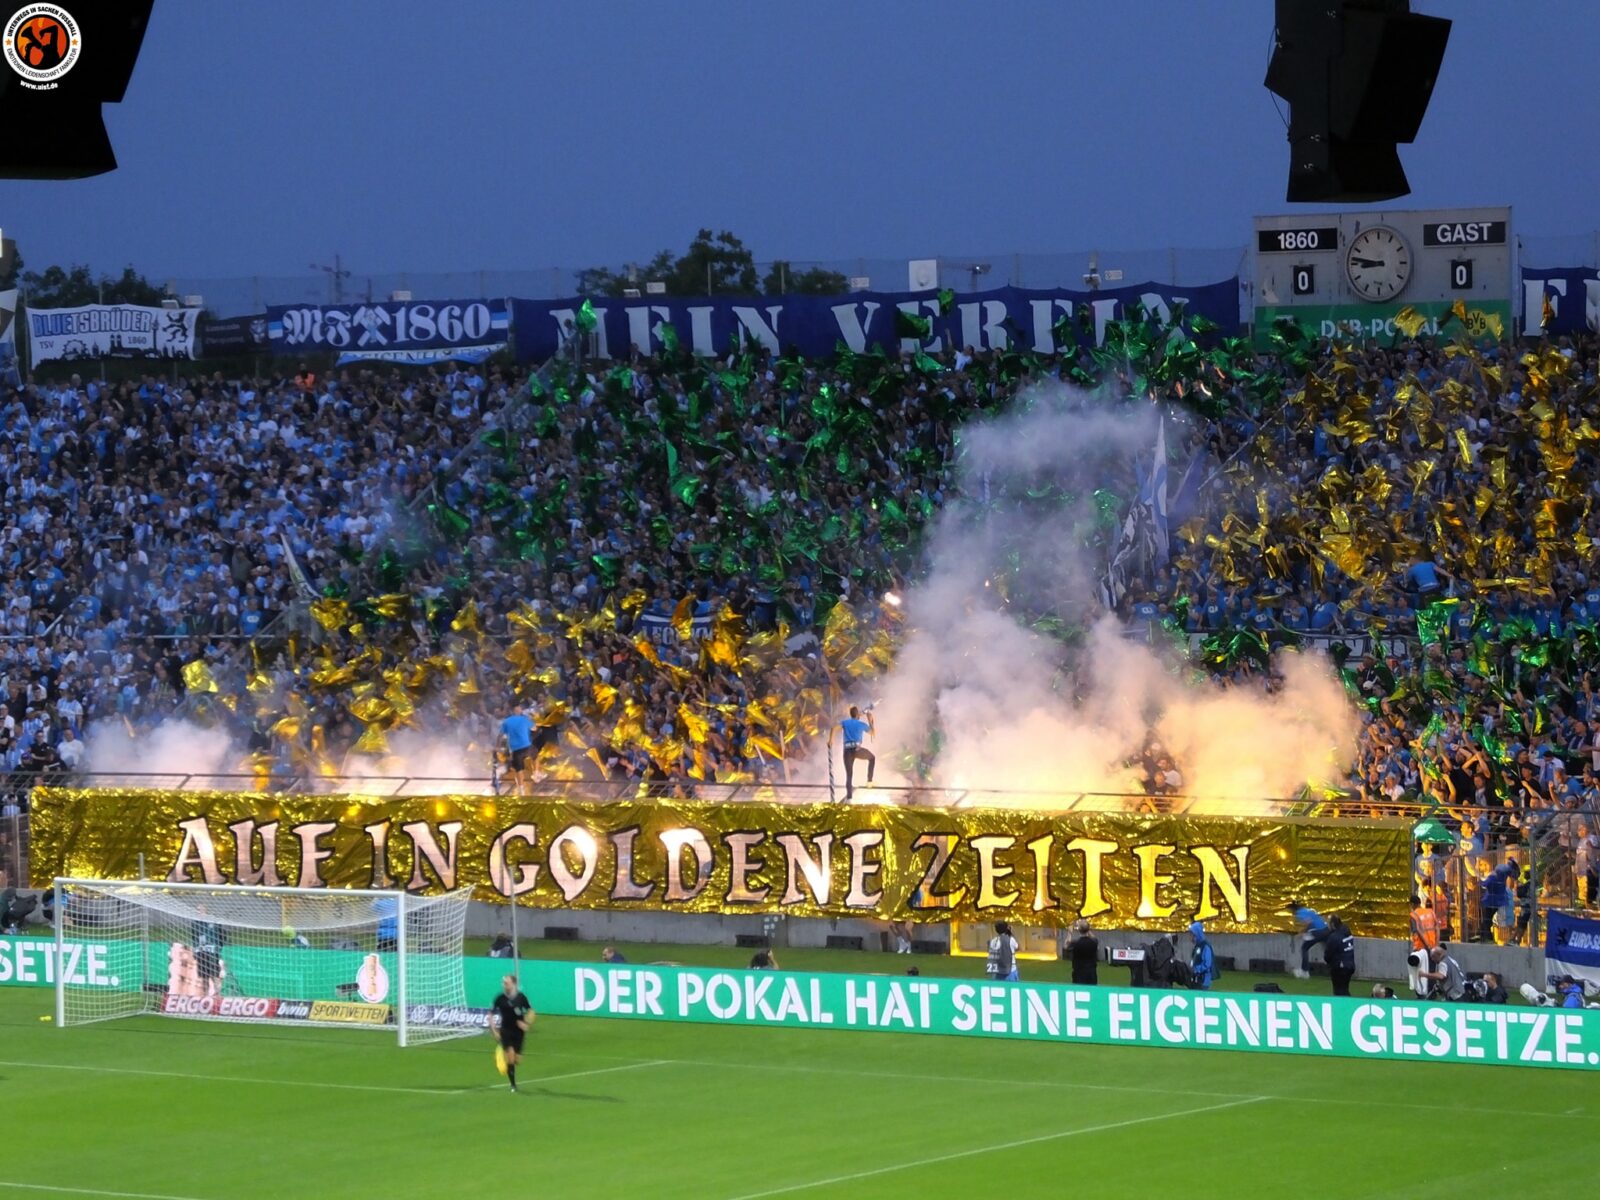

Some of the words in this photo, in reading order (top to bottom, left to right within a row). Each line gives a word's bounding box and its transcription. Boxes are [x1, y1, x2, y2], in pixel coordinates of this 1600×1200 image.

[1277, 231, 1319, 249] 1860
[1436, 223, 1492, 243] GAST
[1298, 271, 1309, 290] 0
[1456, 265, 1466, 285] 0
[32, 307, 152, 337] BLUETSBRÜDER
[392, 303, 491, 344] 1860
[1466, 312, 1487, 330] BVB
[40, 341, 55, 349] TSV
[128, 336, 147, 345] 1860
[166, 817, 338, 888] AUF
[364, 819, 463, 890] IN
[488, 822, 885, 909] GOLDENE
[908, 831, 1251, 922] ZEITEN
[165, 995, 214, 1014] ERGO
[219, 997, 270, 1016] ERGO
[277, 1002, 309, 1017] bwin
[313, 1004, 386, 1022] SPORTWETTEN
[574, 967, 665, 1016] DER
[678, 972, 834, 1023] POKAL
[846, 980, 939, 1029] HAT
[951, 984, 1093, 1038] SEINE
[1108, 992, 1333, 1050] EIGENEN
[1350, 1004, 1600, 1065] GESETZE.
